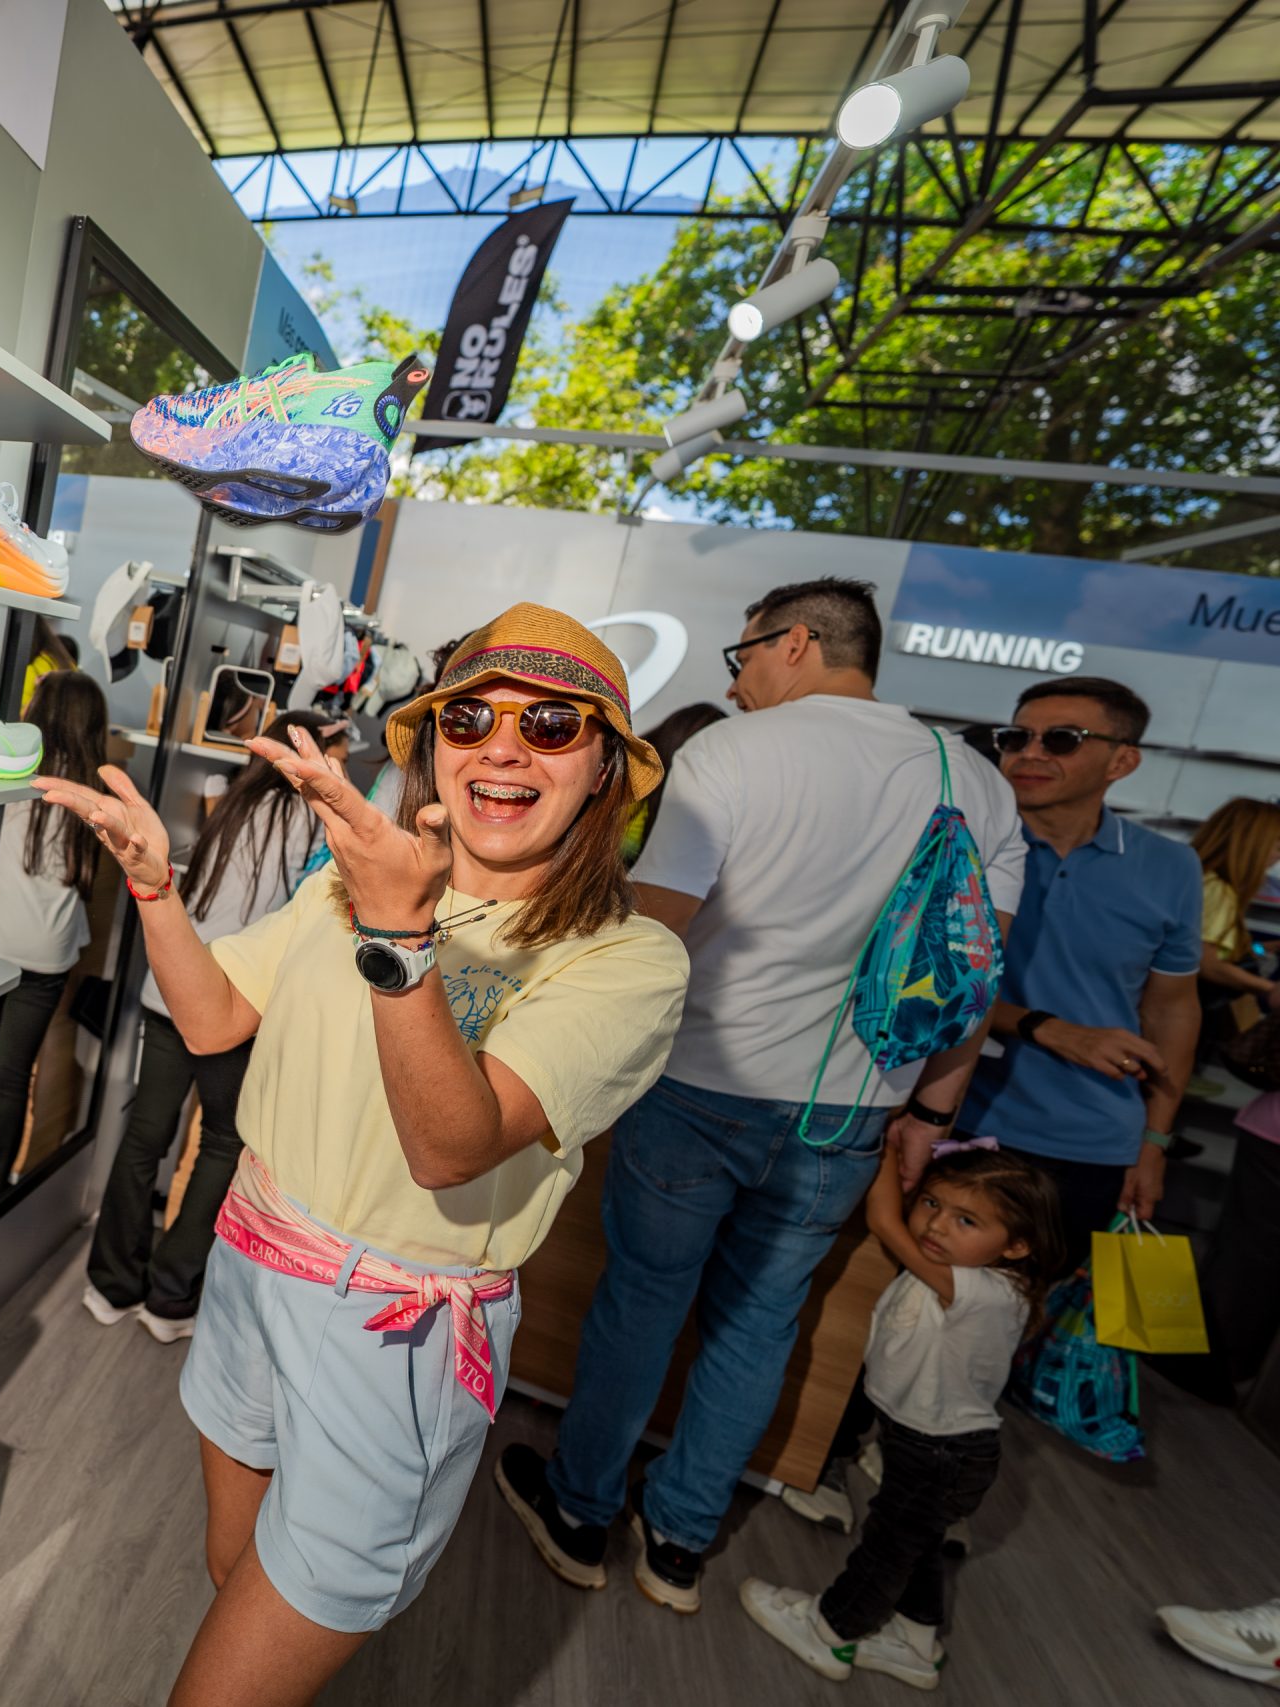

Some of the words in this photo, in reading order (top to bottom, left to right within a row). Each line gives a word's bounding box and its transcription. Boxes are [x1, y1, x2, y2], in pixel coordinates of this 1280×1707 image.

[449, 323, 488, 390] NO
[903, 622, 1085, 674] RUNNING
[249, 1240, 308, 1274] CARIÑO
[311, 1264, 387, 1290] SATO
